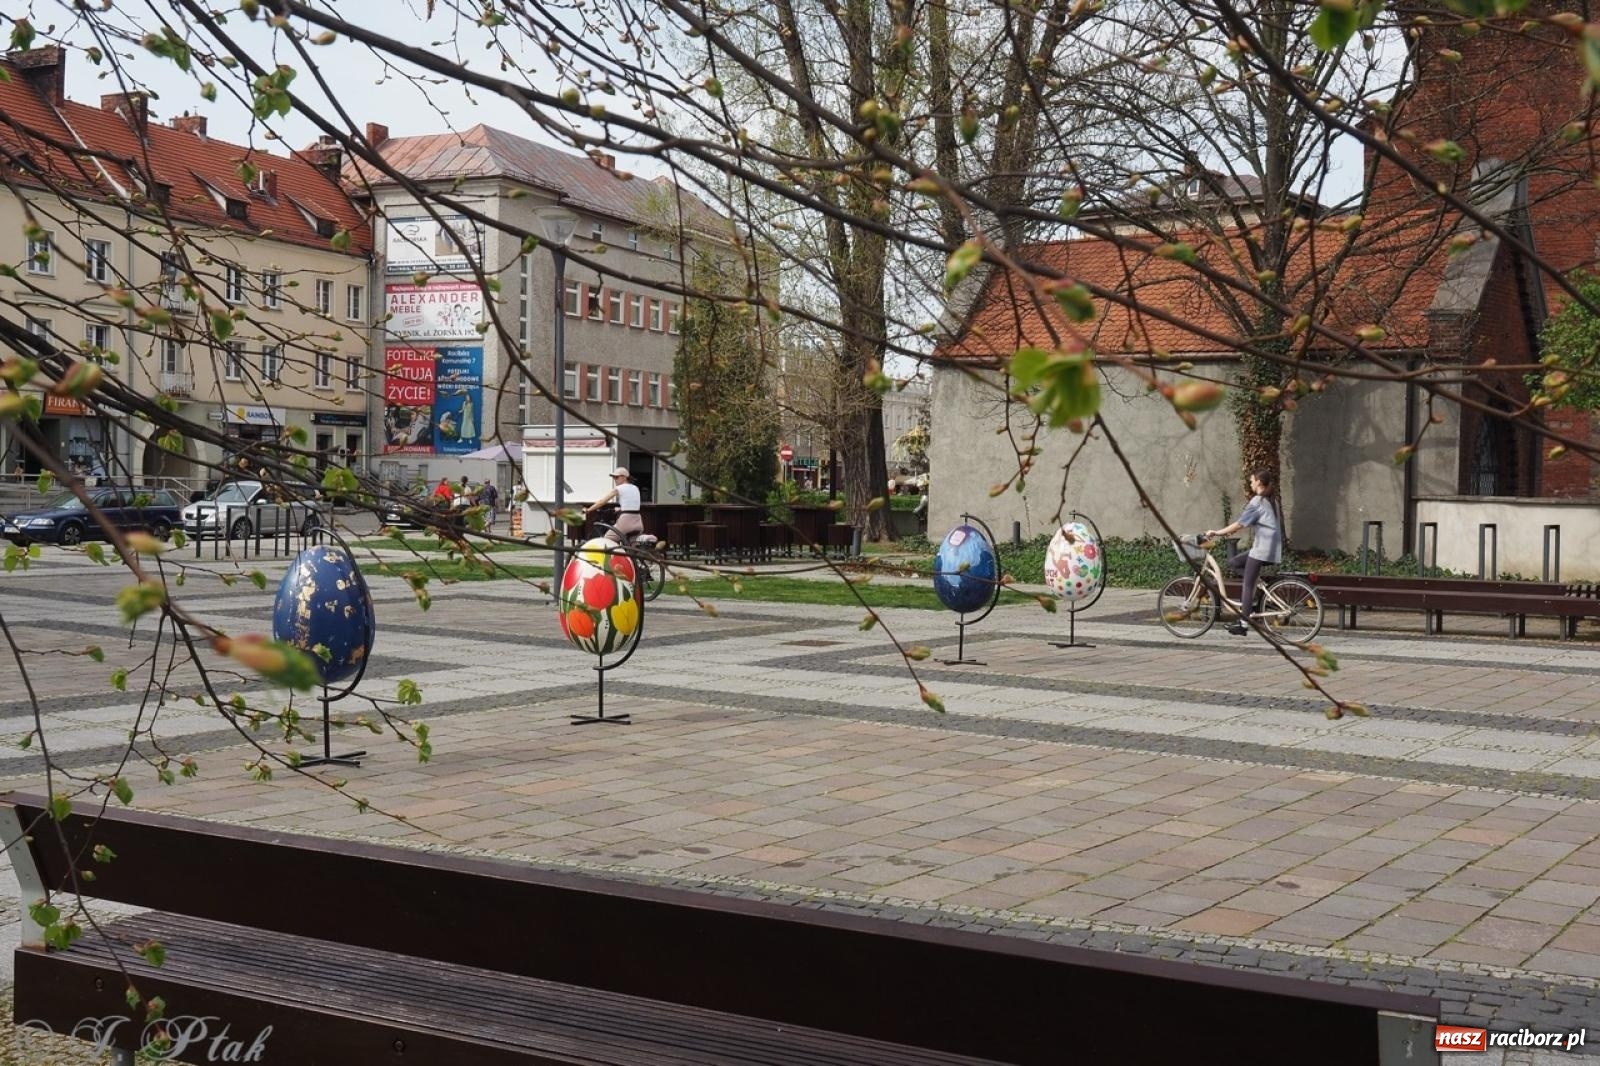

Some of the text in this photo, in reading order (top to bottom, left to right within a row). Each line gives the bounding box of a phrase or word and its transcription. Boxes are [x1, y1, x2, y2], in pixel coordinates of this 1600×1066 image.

[390, 292, 479, 304] ALEXANDER
[390, 305, 421, 314] MEBLE
[388, 383, 431, 400] ŻYCIE!
